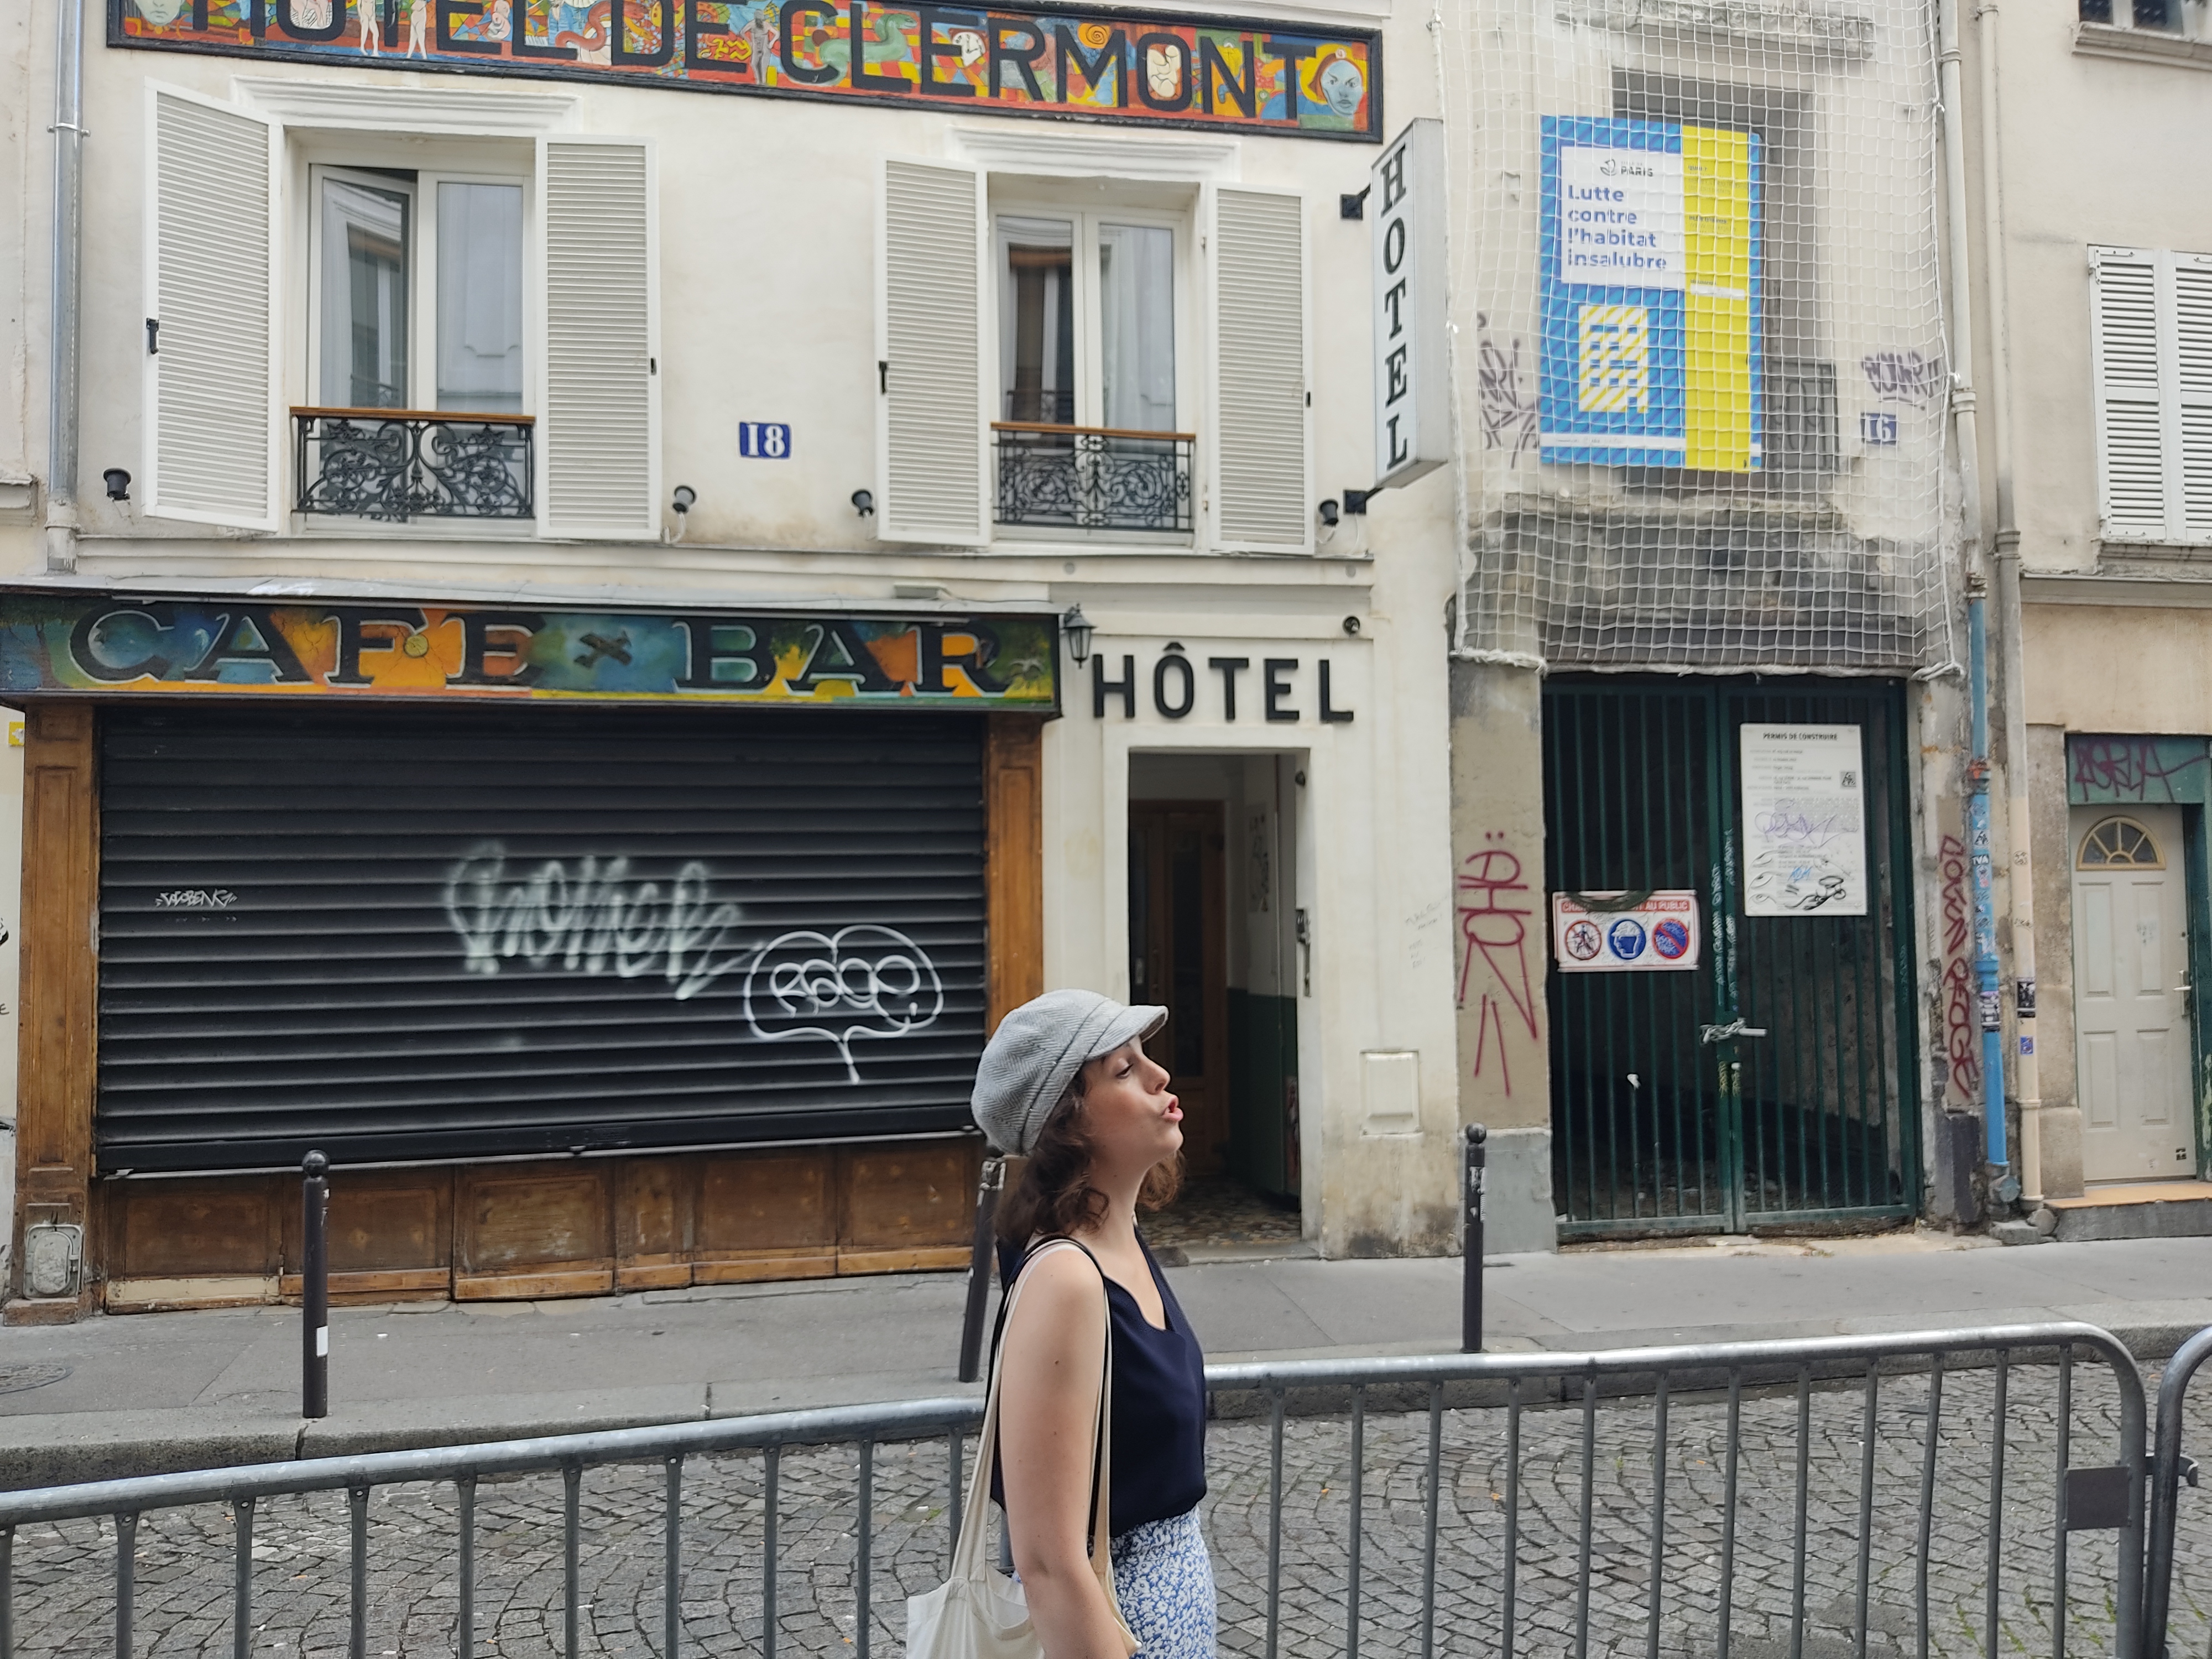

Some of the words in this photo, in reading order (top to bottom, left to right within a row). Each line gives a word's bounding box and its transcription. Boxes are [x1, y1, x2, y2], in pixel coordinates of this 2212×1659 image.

[611, 0, 747, 73] DE
[780, 0, 1316, 119] CLERMONT
[1621, 166, 1653, 177] PARIS
[1568, 185, 1624, 202] Lutte
[1567, 208, 1637, 225] contre
[1568, 228, 1657, 248] l'habitat
[1567, 250, 1667, 270] insalubre
[1380, 144, 1408, 471] HOTEL
[748, 424, 785, 457] 18
[1864, 416, 1891, 442] 16
[69, 603, 546, 691] CAFE
[671, 616, 1012, 698] BAR
[1092, 641, 1354, 724] HÔTEL
[1646, 900, 1657, 910] AU
[1658, 900, 1688, 911] PUBLIC
